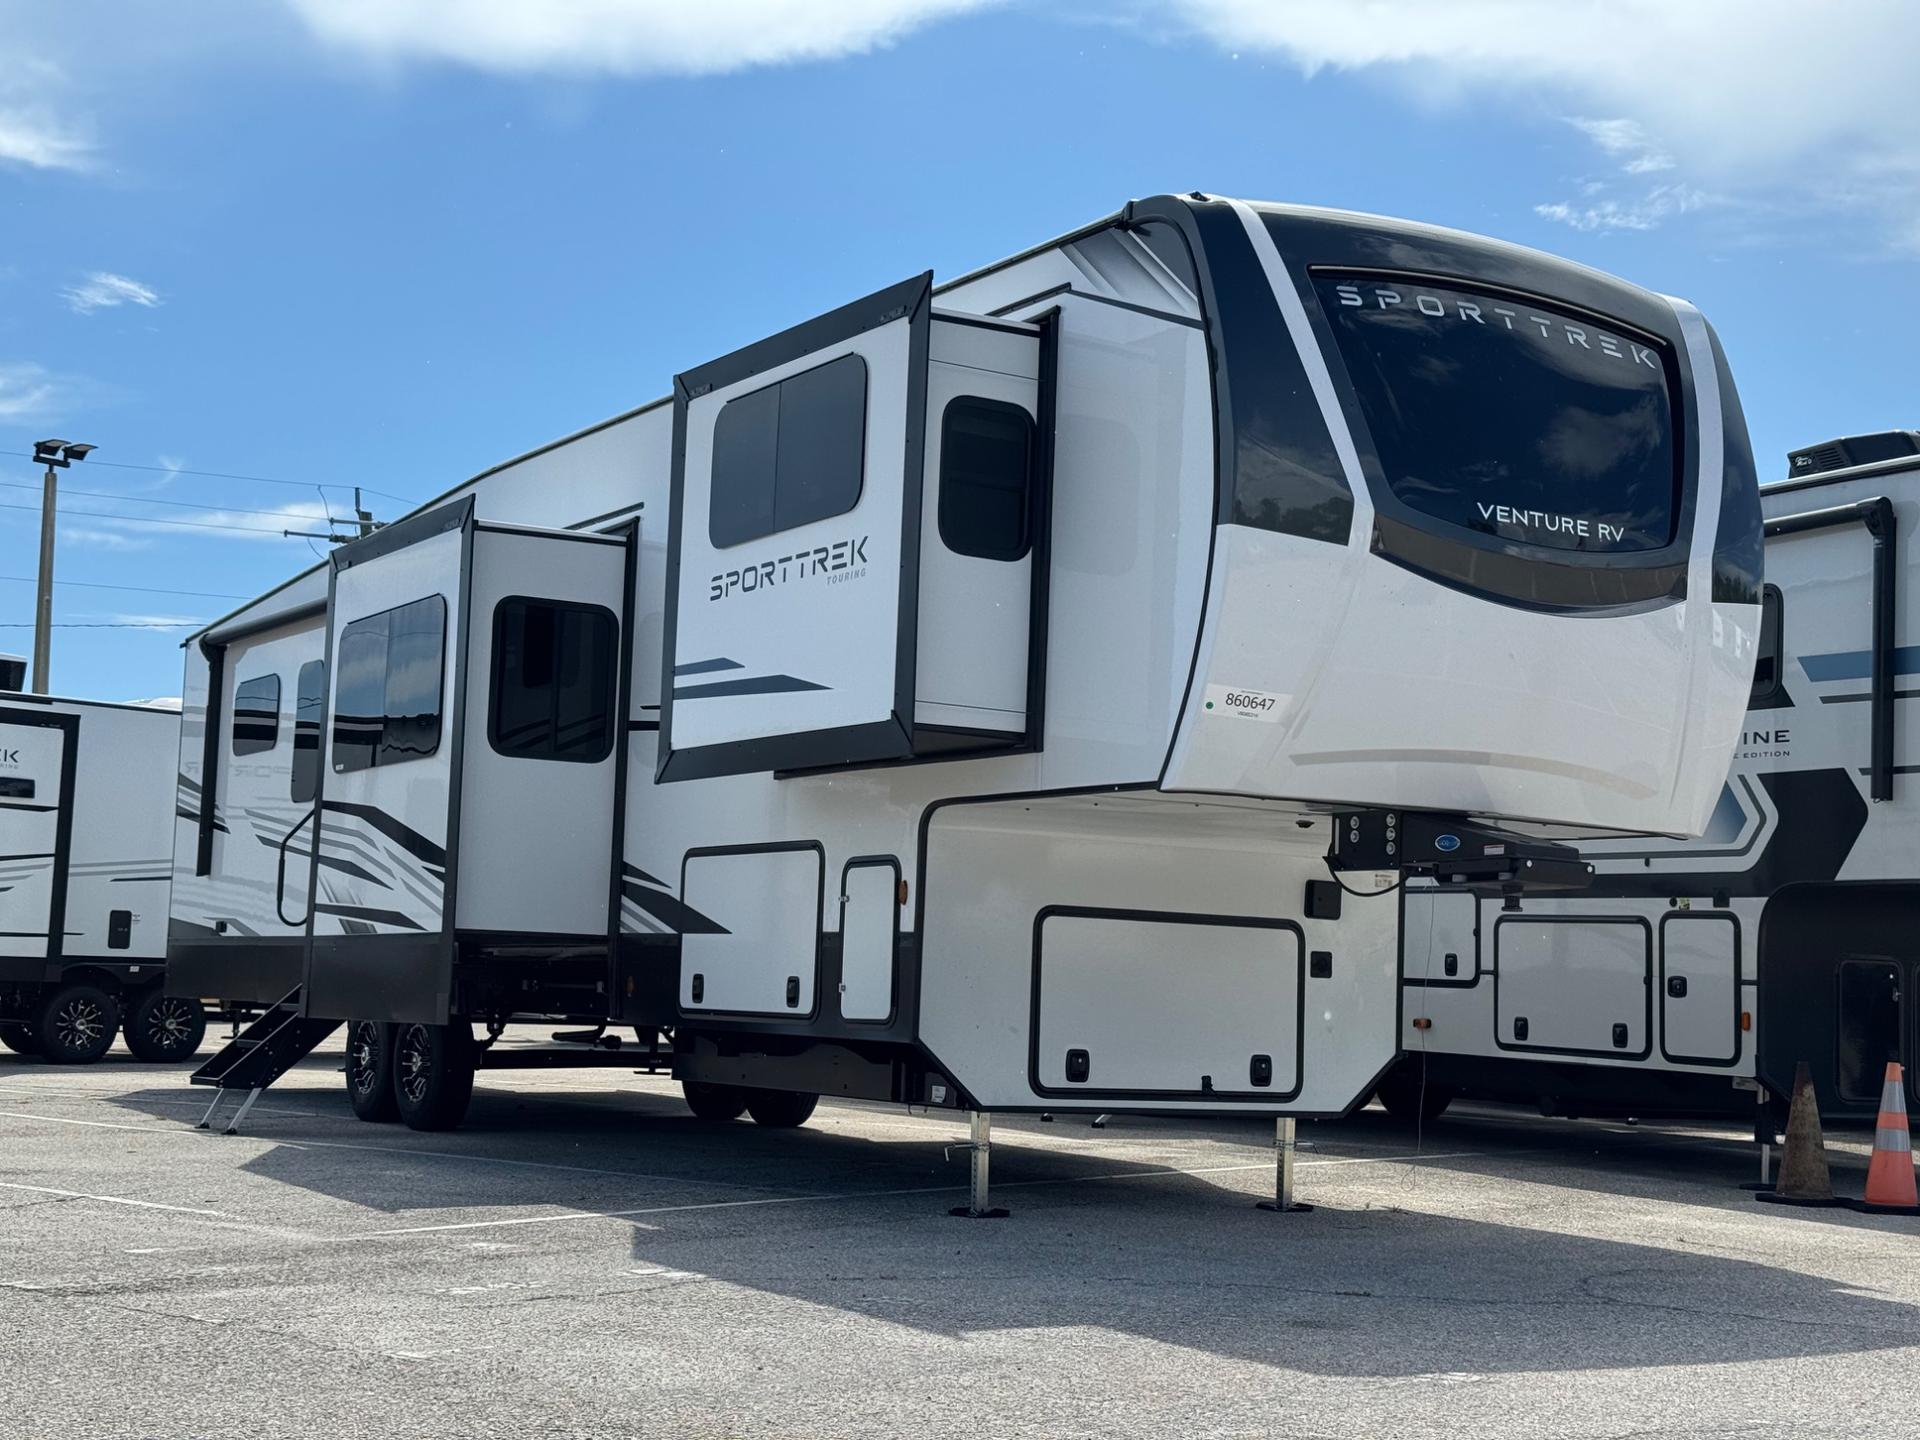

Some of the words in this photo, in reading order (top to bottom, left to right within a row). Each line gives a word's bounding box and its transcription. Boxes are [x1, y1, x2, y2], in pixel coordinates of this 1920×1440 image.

[1335, 285, 1656, 369] SPORTTREK
[1476, 502, 1590, 537] VENTURE
[1598, 523, 1625, 543] RV
[709, 536, 869, 602] SPORTTREK
[826, 567, 866, 586] TOURING
[1225, 692, 1276, 711] 860647
[1743, 729, 1791, 745] INE
[1743, 750, 1790, 759] EDITION
